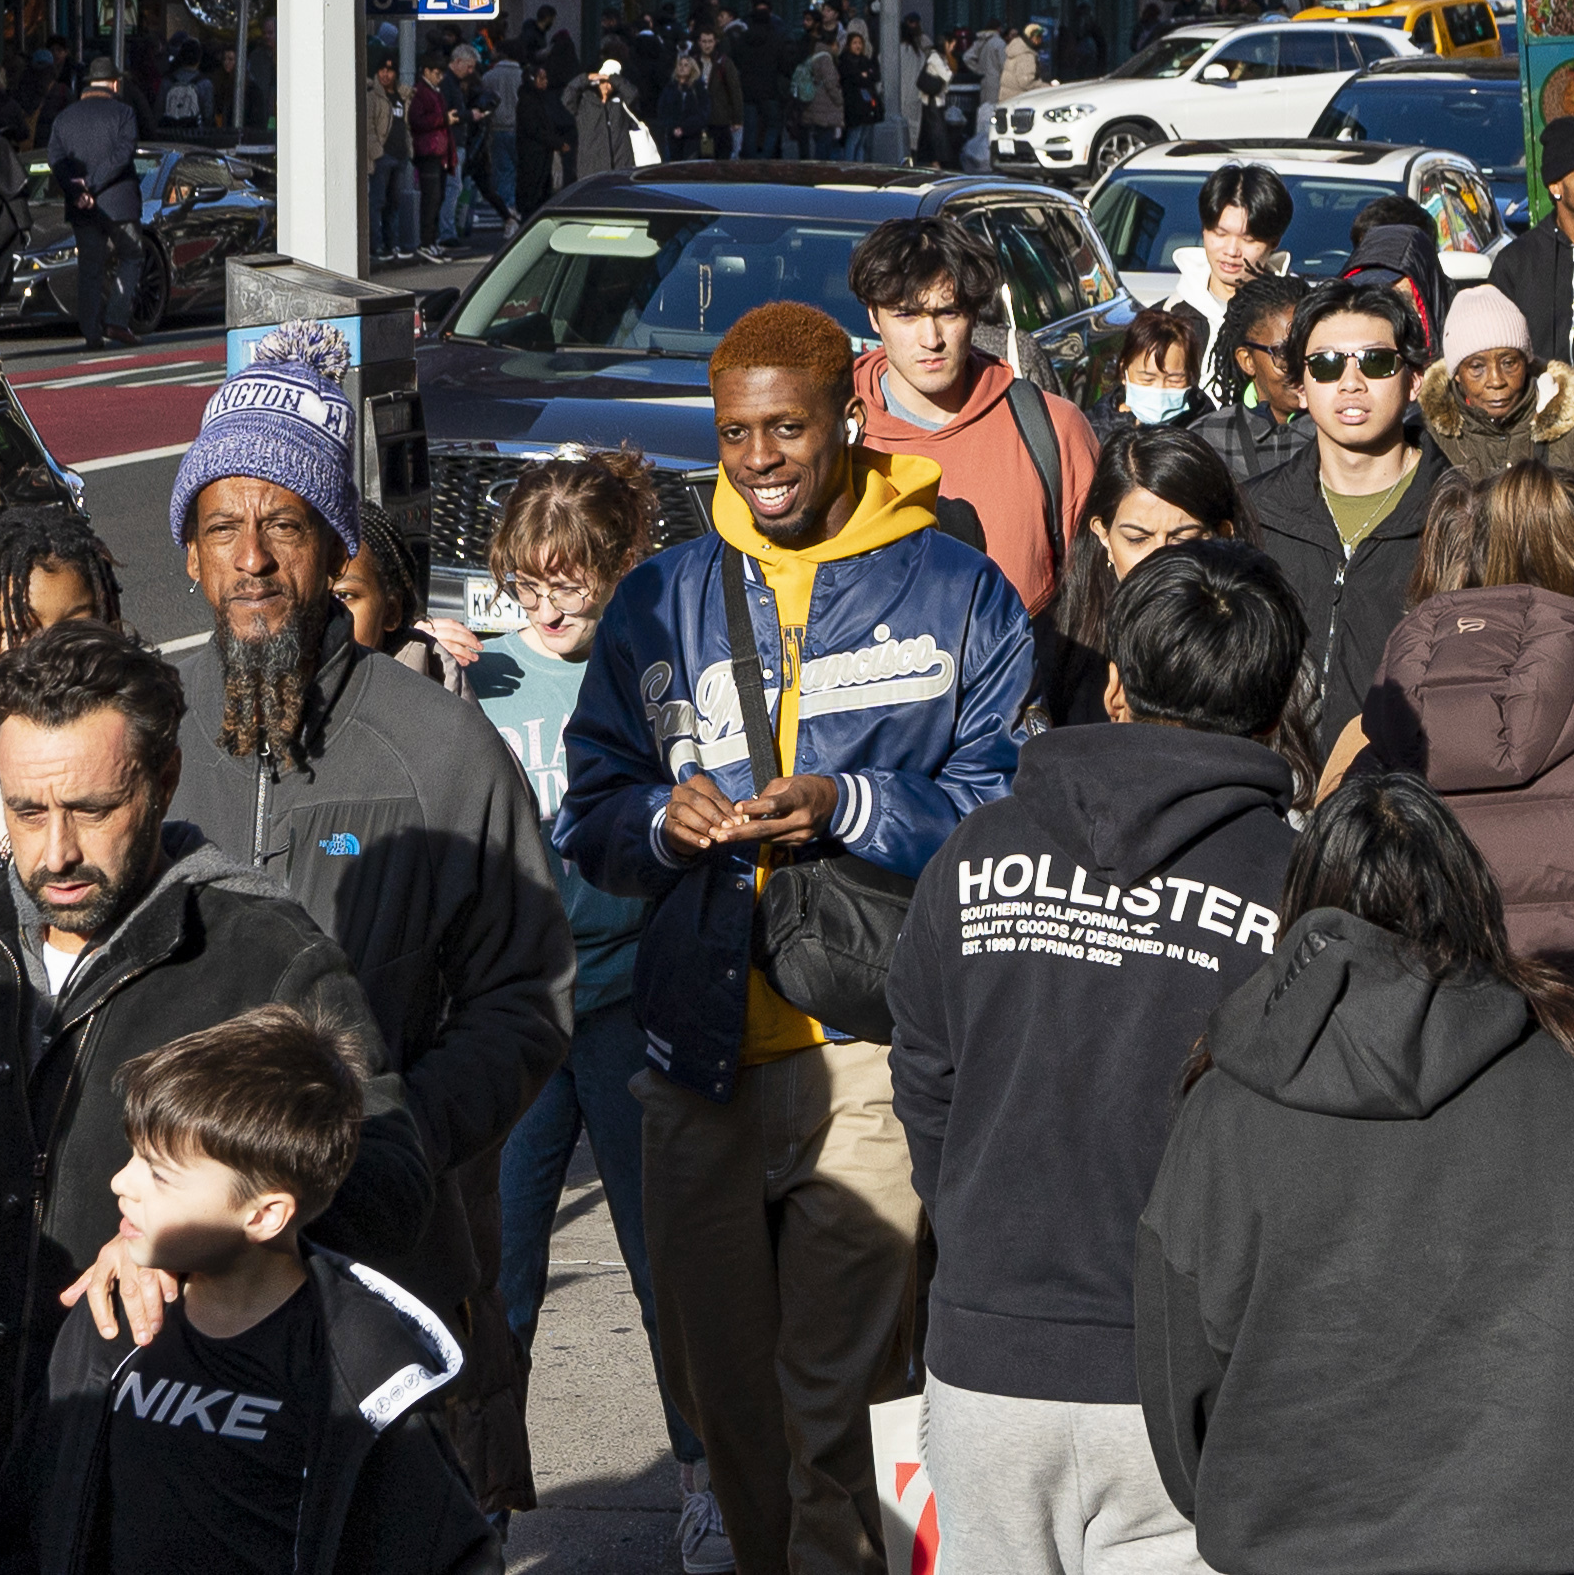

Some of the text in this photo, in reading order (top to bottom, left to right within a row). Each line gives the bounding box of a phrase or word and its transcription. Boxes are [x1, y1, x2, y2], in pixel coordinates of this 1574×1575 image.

[695, 623, 954, 745] Fancisco
[318, 839, 346, 849] NORTH
[326, 847, 347, 856] FACE
[332, 832, 345, 841] THE
[958, 853, 1281, 955] HOLLISTER
[960, 901, 1129, 933] SOUTHERN CALIFORNIA
[961, 919, 1012, 939] QUALITY
[1015, 920, 1070, 939] GOODS
[1084, 928, 1164, 956] DESIGNED
[1166, 943, 1185, 960] IN
[1186, 948, 1220, 972] USA
[961, 937, 983, 956] EST.
[984, 937, 1016, 952] 1999
[1030, 937, 1085, 959] SPRING
[1087, 946, 1122, 967] 2022
[113, 1370, 284, 1442] NIKE
